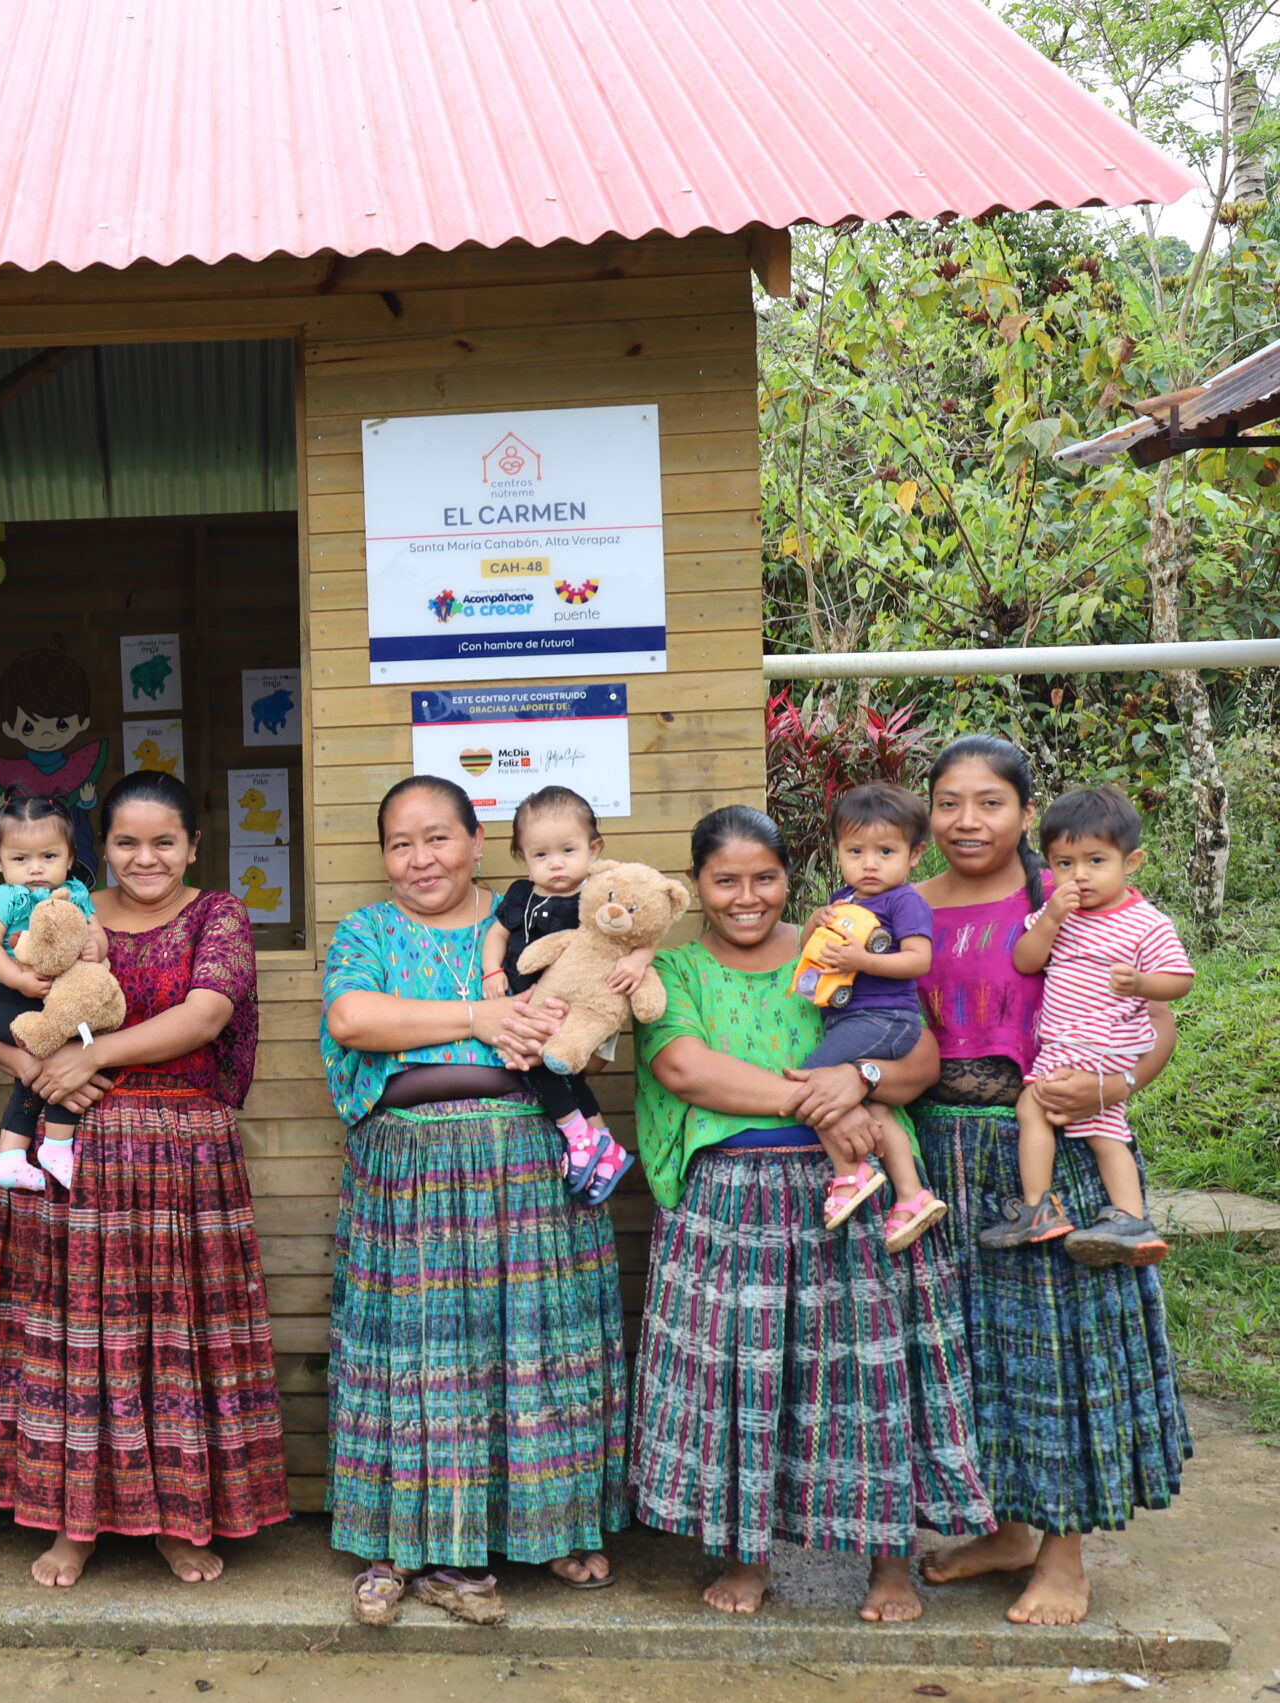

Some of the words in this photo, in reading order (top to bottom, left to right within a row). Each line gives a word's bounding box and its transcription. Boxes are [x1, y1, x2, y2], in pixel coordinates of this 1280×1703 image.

[491, 479, 533, 489] centros
[491, 488, 535, 499] nútreme
[443, 508, 472, 527] EL
[478, 502, 586, 525] CARMEN
[409, 542, 445, 554] Santa
[447, 540, 482, 552] María
[484, 537, 543, 551] Cahabón,
[545, 536, 570, 548] Alta
[571, 535, 621, 549] Verapaz
[490, 561, 543, 575] CAH-48
[463, 605, 475, 617] a
[480, 603, 534, 617] crecer
[554, 608, 601, 623] puente
[458, 641, 482, 653] ¡Con
[483, 639, 524, 651] hambre
[526, 638, 539, 649] de
[541, 637, 575, 649] futuro!
[452, 696, 474, 704] ESTE
[475, 694, 510, 704] CENTRO
[511, 693, 530, 702] FUE
[531, 691, 587, 702] CONSTRUIDO
[469, 705, 507, 714] GRACIAS
[508, 704, 520, 713] AL
[520, 703, 554, 712] APORTE
[555, 702, 571, 711] DE:
[498, 759, 519, 767] Feliz
